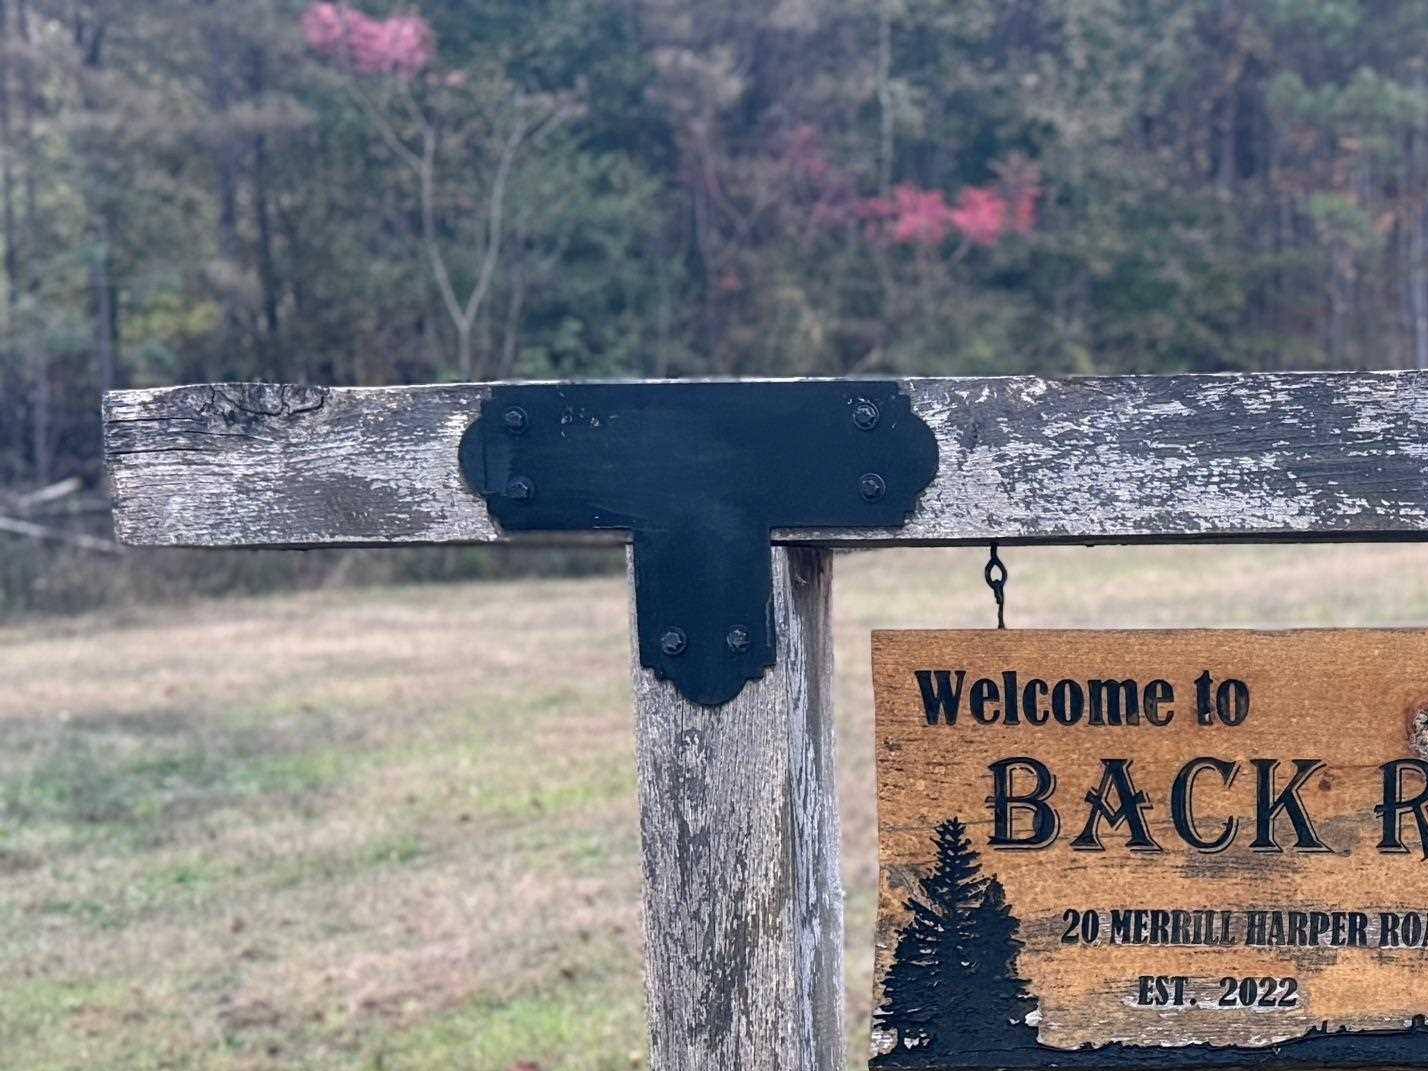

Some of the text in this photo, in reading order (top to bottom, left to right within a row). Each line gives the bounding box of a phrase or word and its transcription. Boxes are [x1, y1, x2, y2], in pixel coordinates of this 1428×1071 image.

[914, 669, 1251, 727] Welcome to
[985, 756, 1336, 855] BACK
[1061, 908, 1099, 945] 20
[1109, 908, 1237, 946] MERRILL
[1245, 909, 1368, 948] HARPER
[1137, 974, 1299, 1008] EST. 2022
